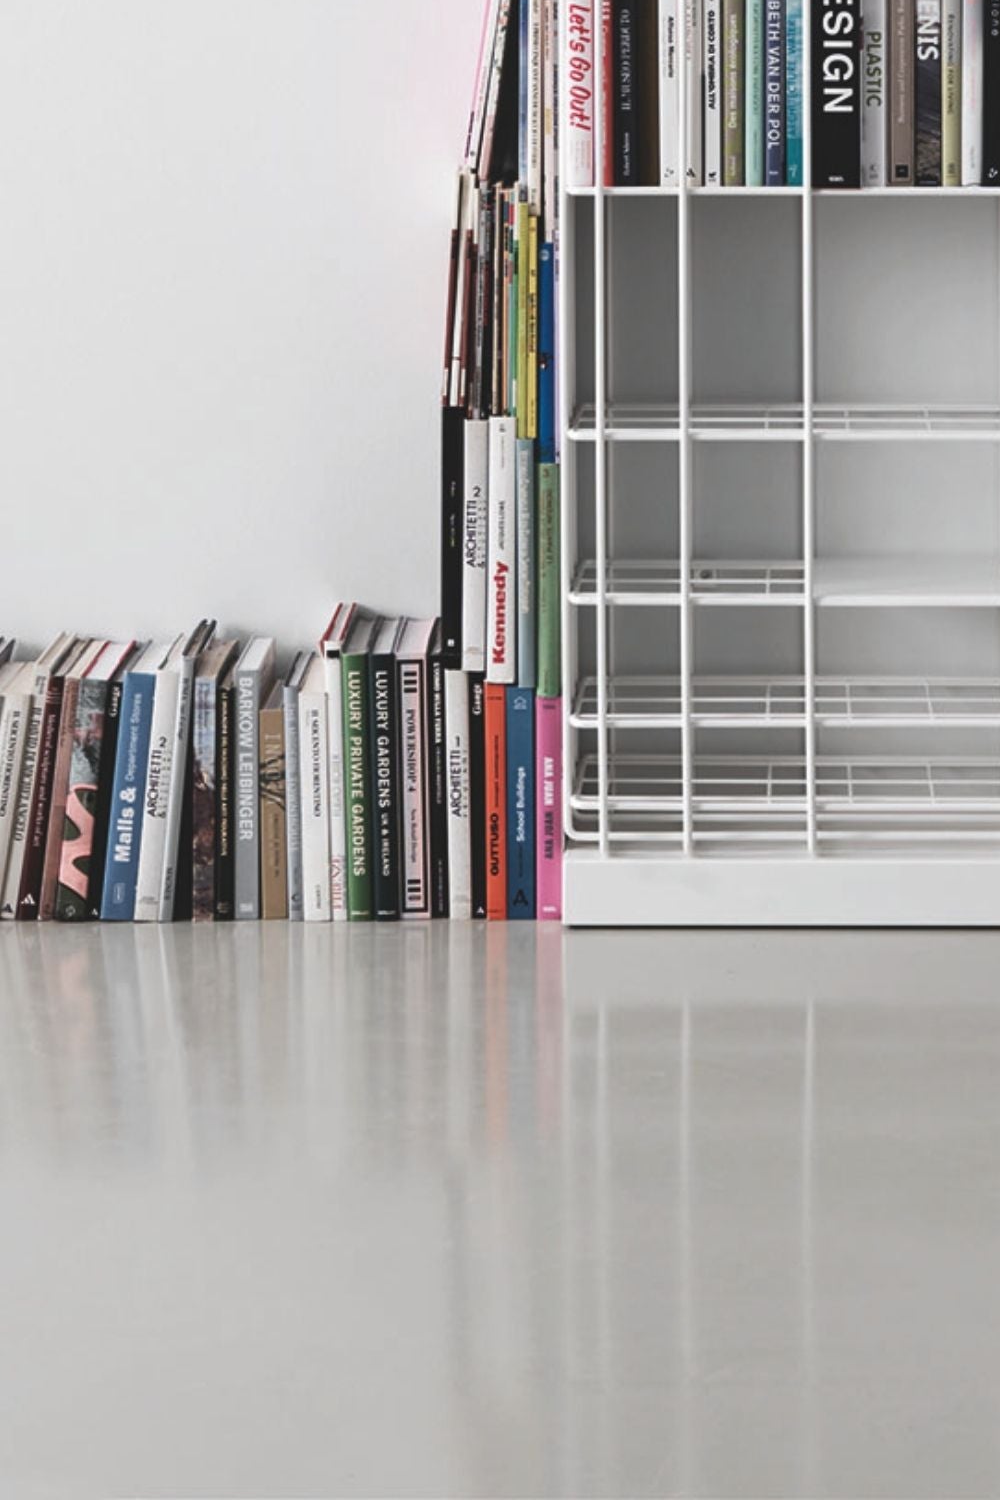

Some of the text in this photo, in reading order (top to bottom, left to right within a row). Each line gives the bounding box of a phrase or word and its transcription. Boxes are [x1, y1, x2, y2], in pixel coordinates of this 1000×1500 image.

[708, 10, 716, 42] CORTO
[569, 4, 591, 131] Let's Go Out!
[728, 71, 738, 109] maisons
[767, 46, 779, 76] VAN
[866, 32, 882, 107] PLASTIC
[728, 112, 738, 128] Des
[767, 82, 779, 113] DER
[767, 119, 779, 150] POL
[466, 500, 477, 568] ARCHITETTI
[492, 561, 508, 664] Kennedy
[375, 670, 388, 730] LUXURY
[239, 677, 254, 841] BARKOW LEIBINGER
[348, 670, 366, 876] LUXURY PRIVATE GARDENS
[377, 736, 390, 808] GARDENS
[406, 708, 418, 782] POWERSHOP
[14, 763, 35, 842] MICHELANGELO
[39, 787, 48, 800] and
[114, 693, 142, 863] Malls & Department Stores
[147, 749, 163, 818] ARCHITETTI
[313, 762, 321, 818] FIORENTINO
[450, 750, 462, 818] ARCHITETTI
[515, 766, 526, 842] School Buildings
[544, 756, 554, 806] ANA JUAN
[381, 813, 388, 826] UK
[490, 813, 500, 877] GUTTUSO
[544, 811, 554, 860] ANA JUAN
[382, 838, 390, 876] IRELAND
